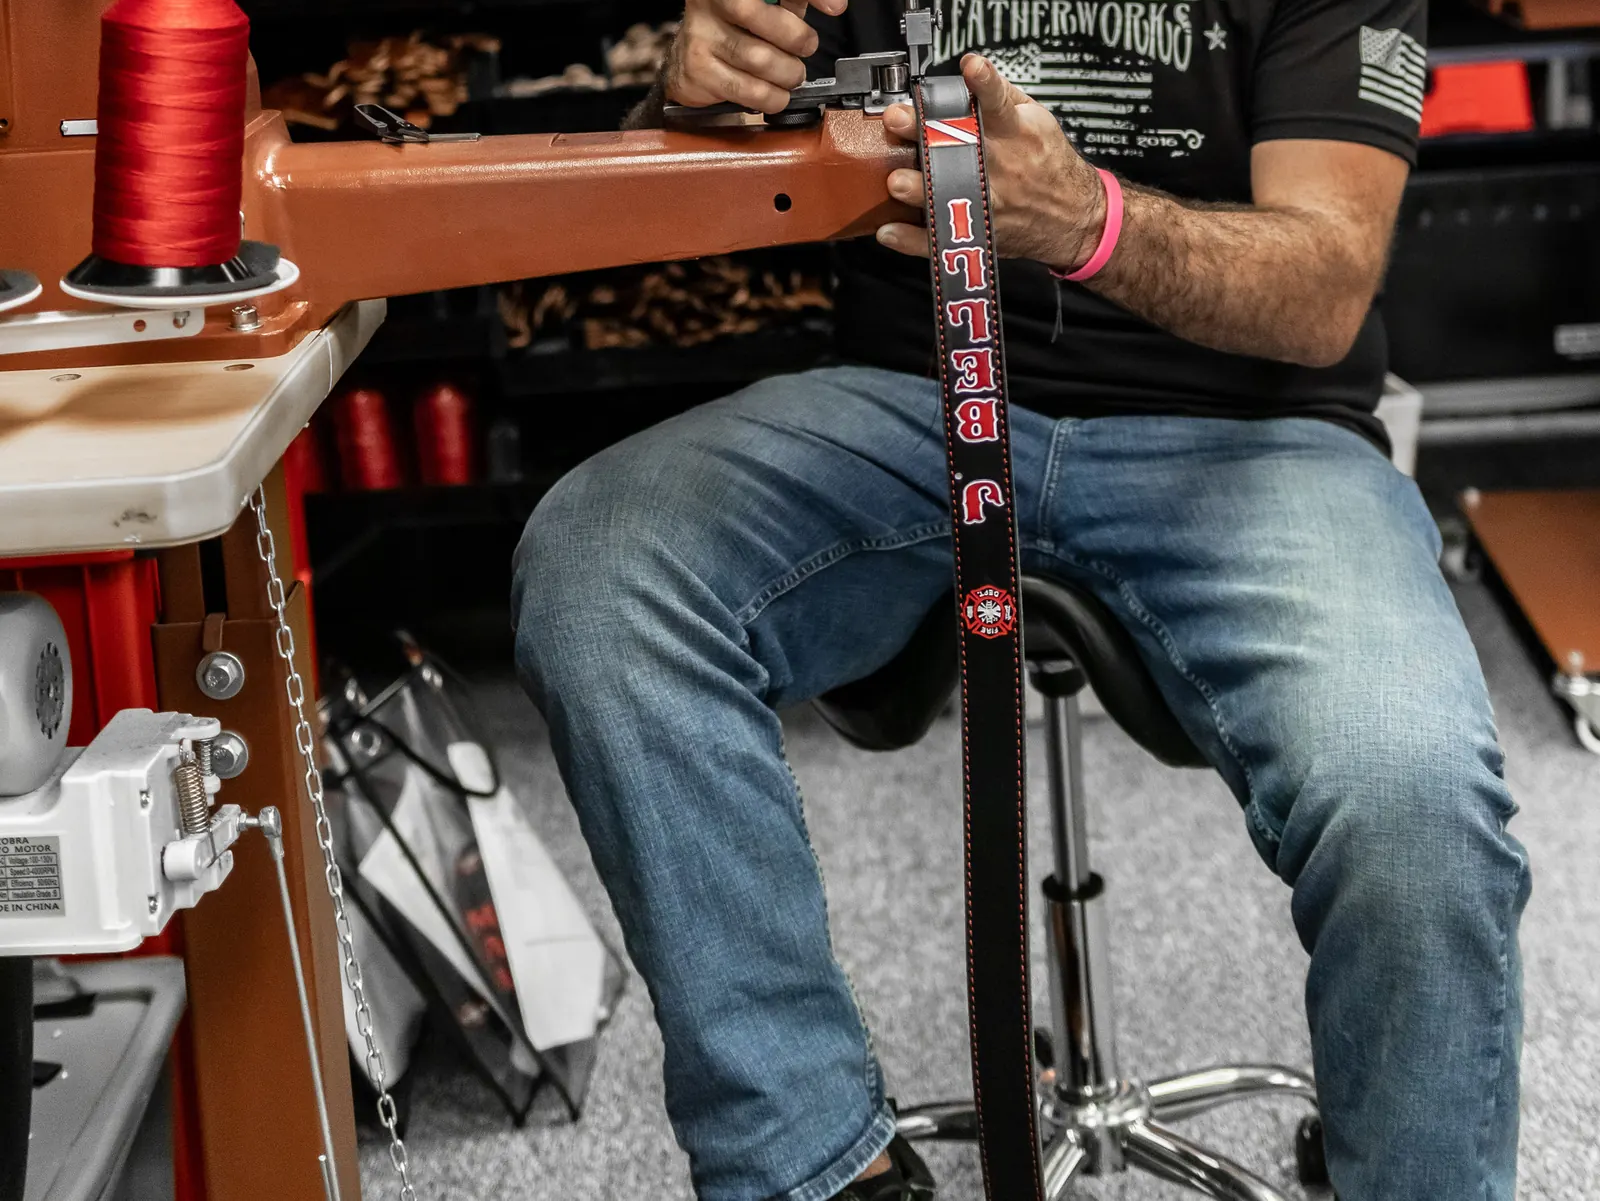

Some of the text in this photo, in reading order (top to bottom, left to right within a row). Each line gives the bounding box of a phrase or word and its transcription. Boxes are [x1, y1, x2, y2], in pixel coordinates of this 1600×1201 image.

[1084, 133, 1129, 145] SINCE
[1136, 136, 1179, 148] 2016
[980, 626, 999, 635] FIRE
[0, 837, 29, 845] OBRA
[14, 844, 52, 853] MOTOR
[25, 902, 60, 911] CHINA
